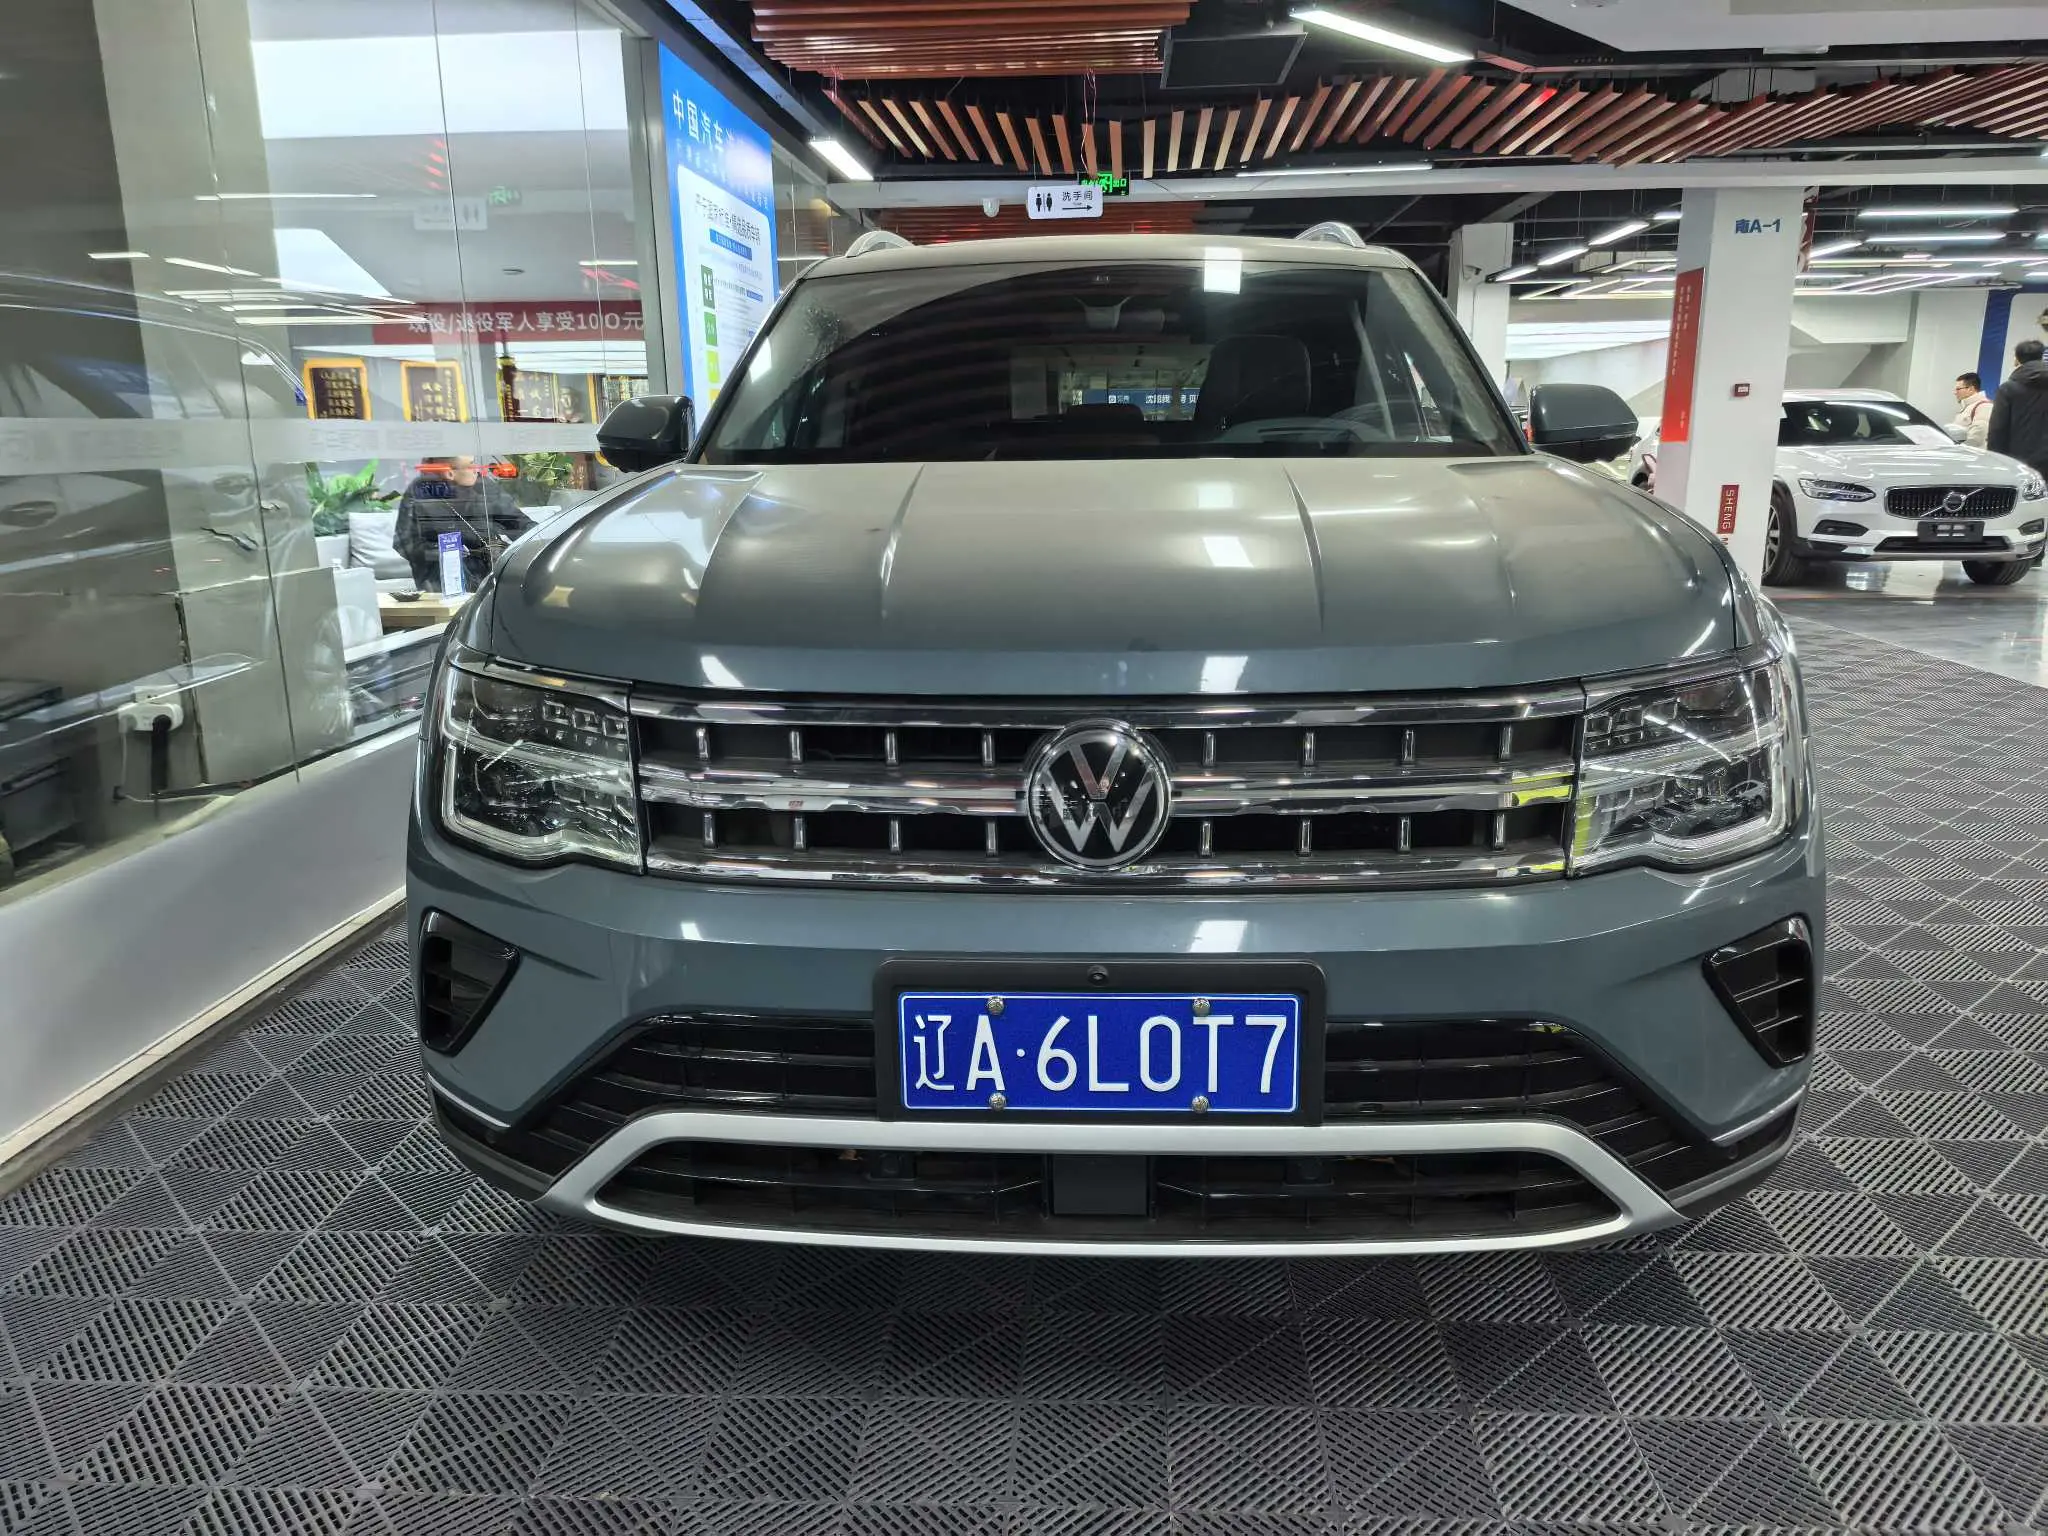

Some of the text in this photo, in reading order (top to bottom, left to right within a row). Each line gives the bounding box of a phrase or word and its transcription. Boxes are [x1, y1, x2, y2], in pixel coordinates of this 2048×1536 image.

[1062, 191, 1093, 202] 洗手间
[1721, 489, 1736, 530] SHENG
[912, 1013, 1288, 1094] 辽A·6L0T7
